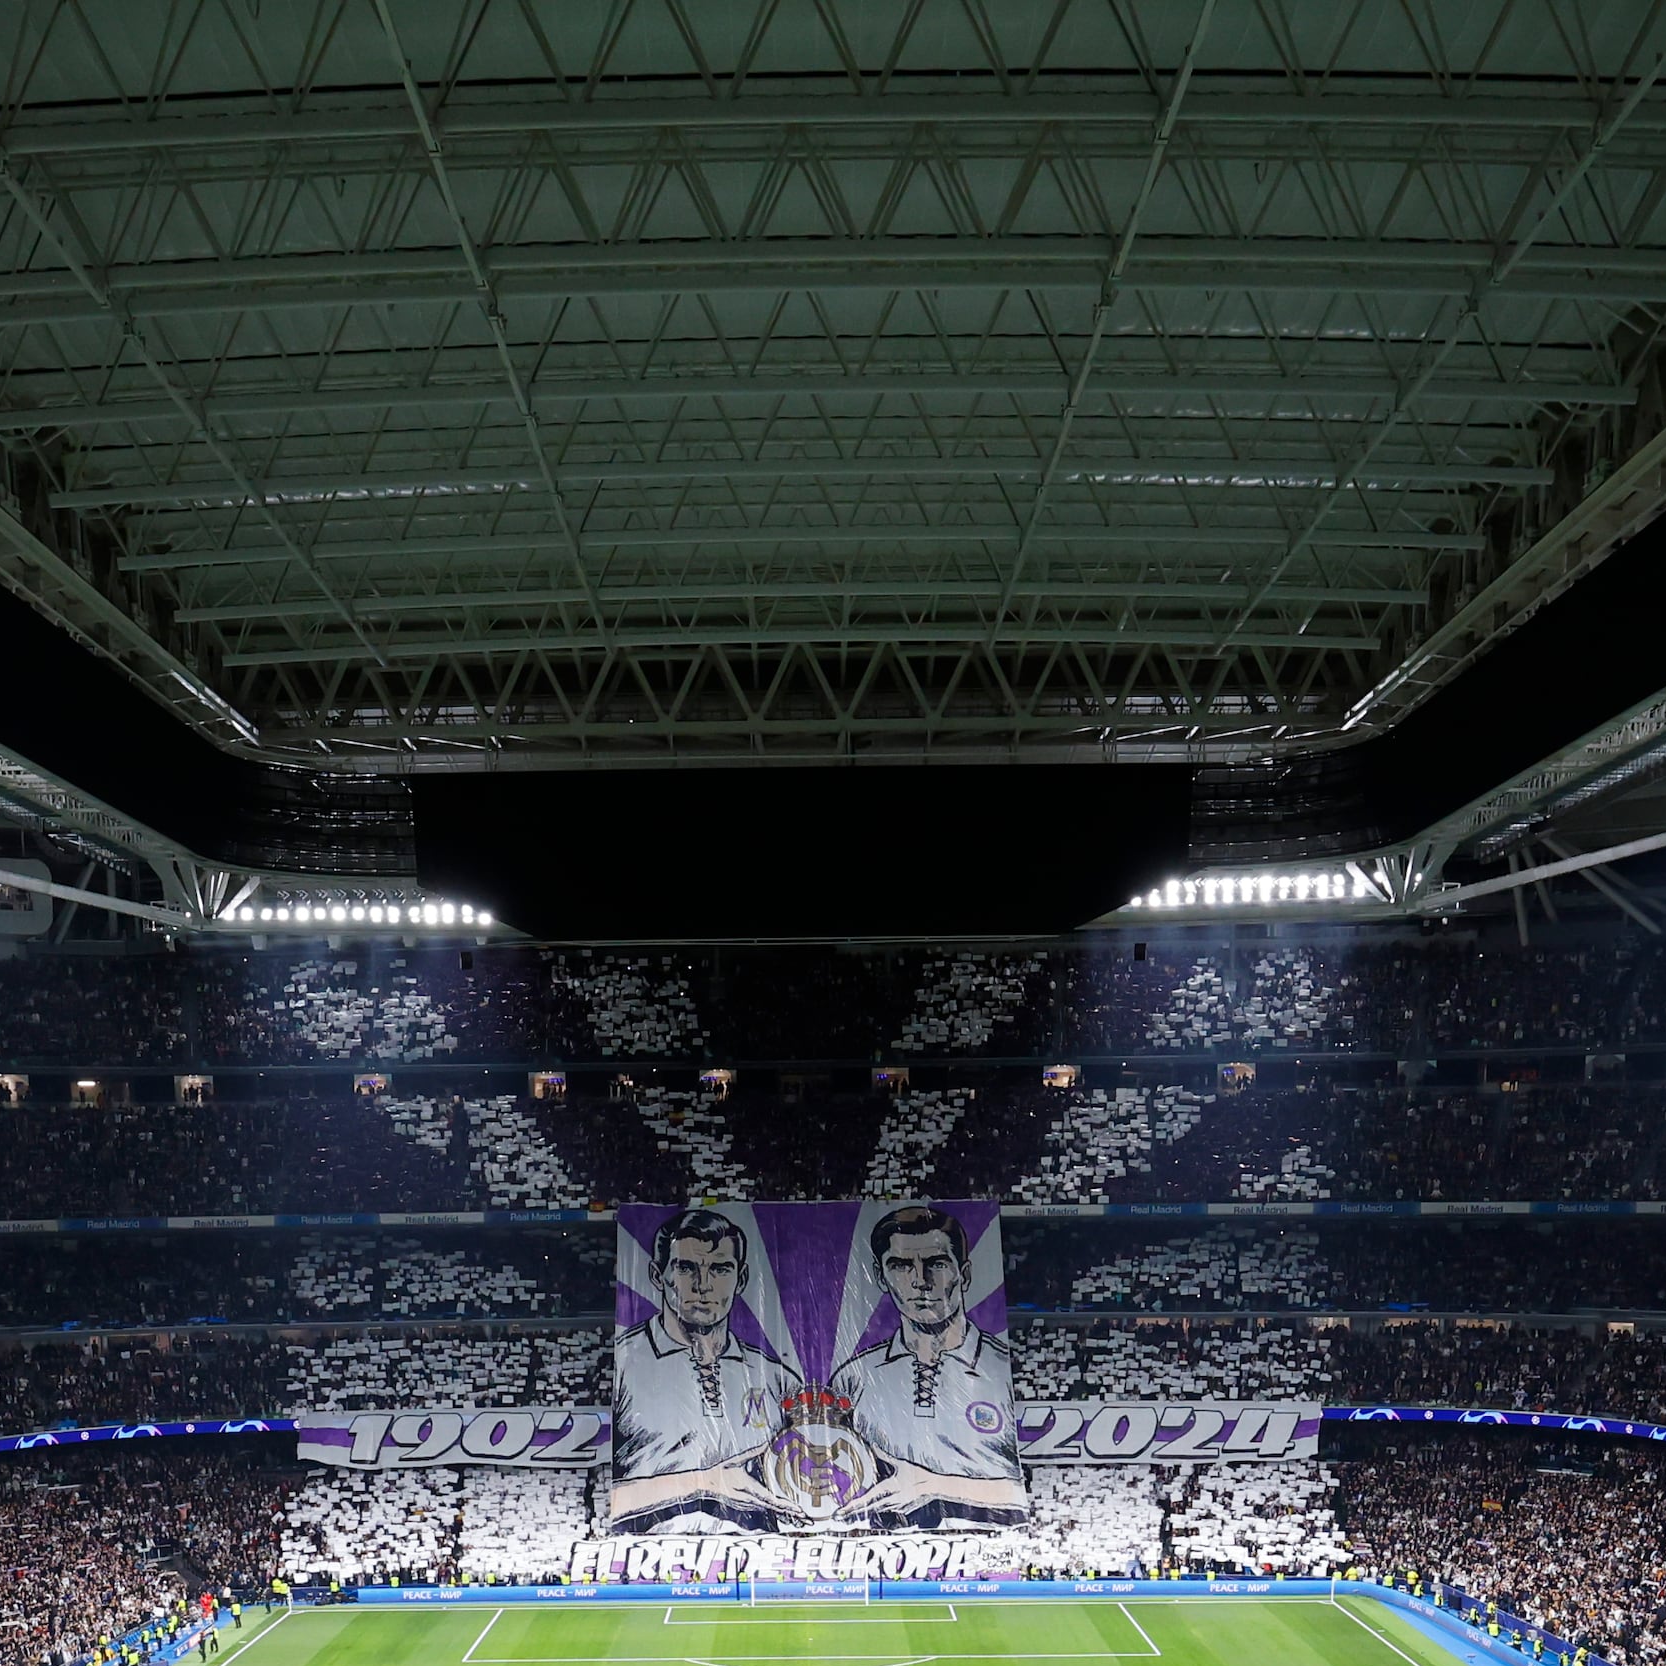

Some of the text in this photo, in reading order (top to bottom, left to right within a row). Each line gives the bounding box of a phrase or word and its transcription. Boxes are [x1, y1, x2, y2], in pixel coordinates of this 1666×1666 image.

[1019, 1406, 1302, 1459] 2024
[348, 1411, 602, 1464] 1902
[571, 1539, 620, 1582] EL
[624, 1538, 721, 1582] REY
[724, 1538, 792, 1583] DE
[791, 1537, 984, 1582] EUROPA
[672, 1586, 700, 1596] PEACE
[806, 1585, 834, 1594] PEACE
[941, 1584, 969, 1592] PEACE
[1075, 1584, 1103, 1592] PEACE
[1210, 1584, 1239, 1592] PEACE
[403, 1591, 431, 1600] PEACE
[537, 1589, 565, 1598] PEACE
